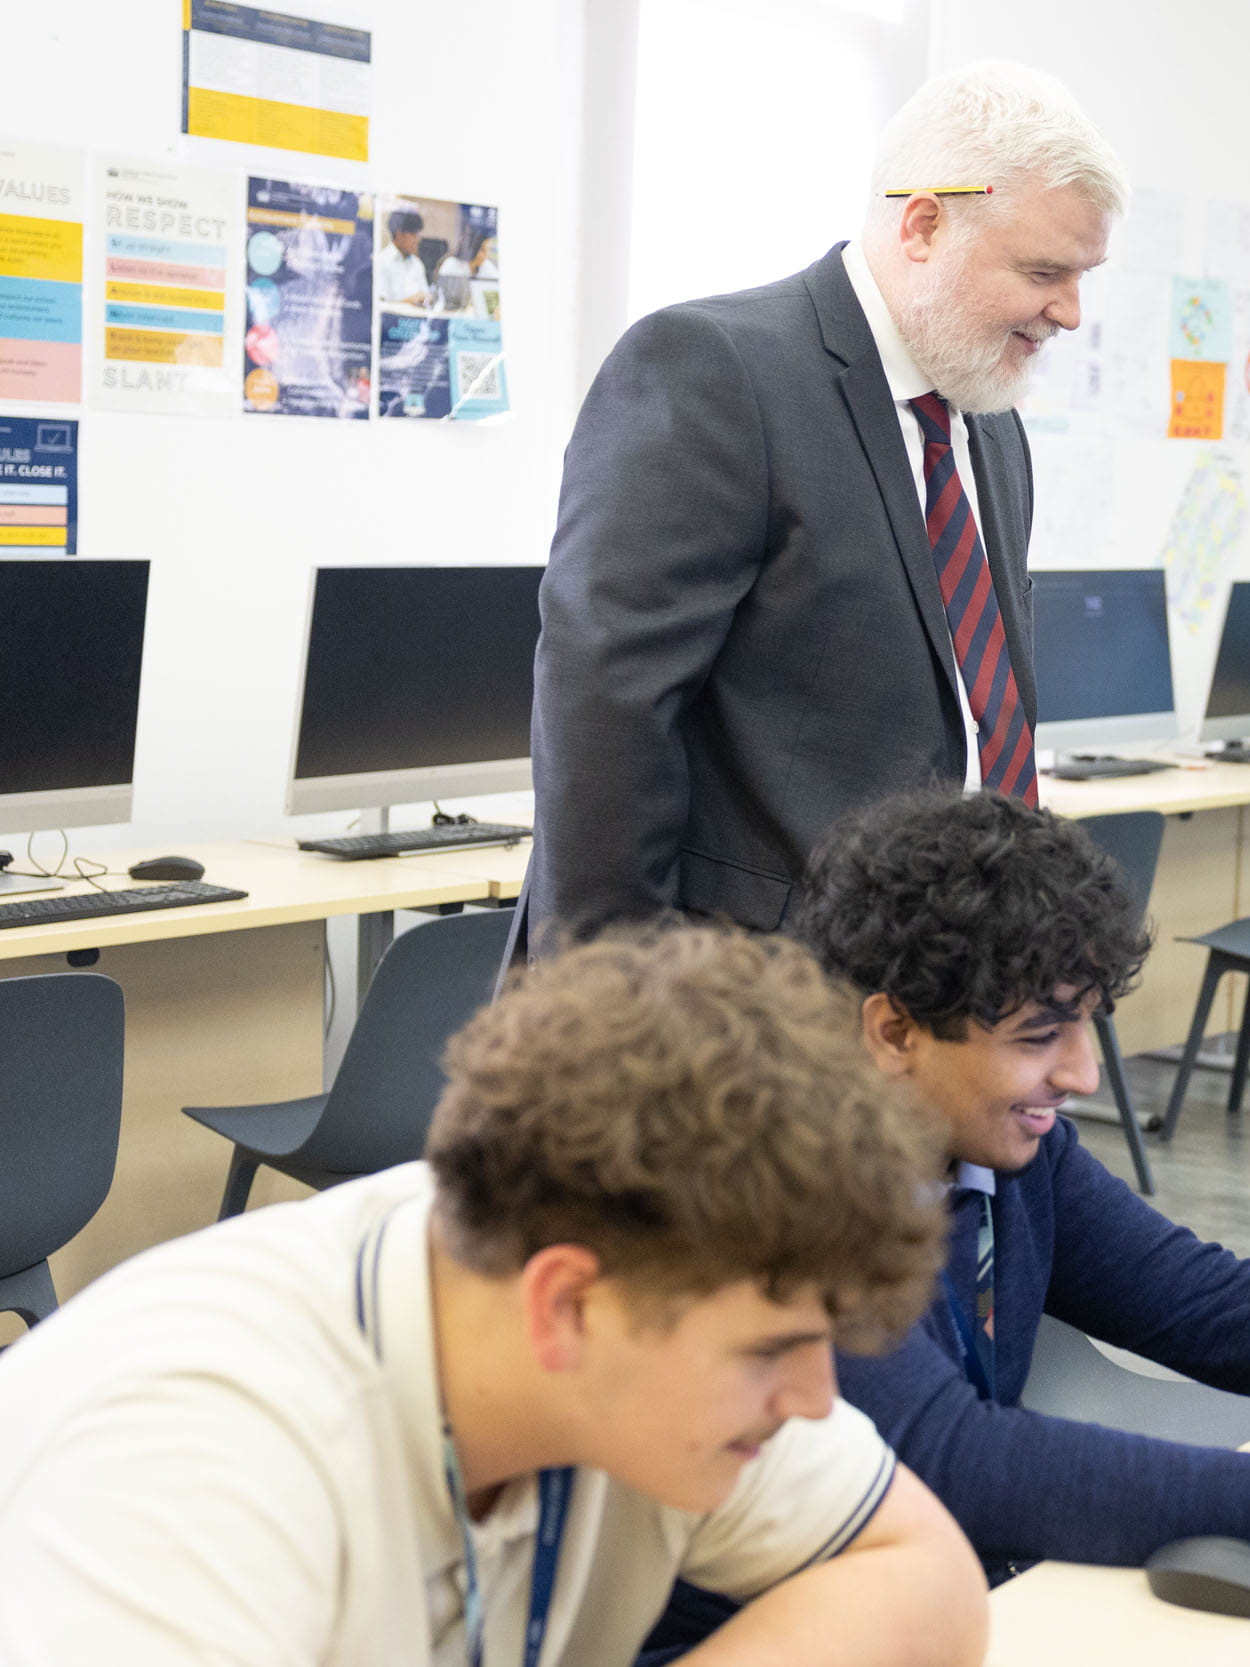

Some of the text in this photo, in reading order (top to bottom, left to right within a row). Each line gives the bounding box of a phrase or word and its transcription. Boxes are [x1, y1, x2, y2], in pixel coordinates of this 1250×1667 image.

[106, 204, 227, 239] RESPECT
[103, 367, 187, 392] SLANT
[18, 465, 53, 478] CLOSE
[54, 466, 67, 478] IT.
